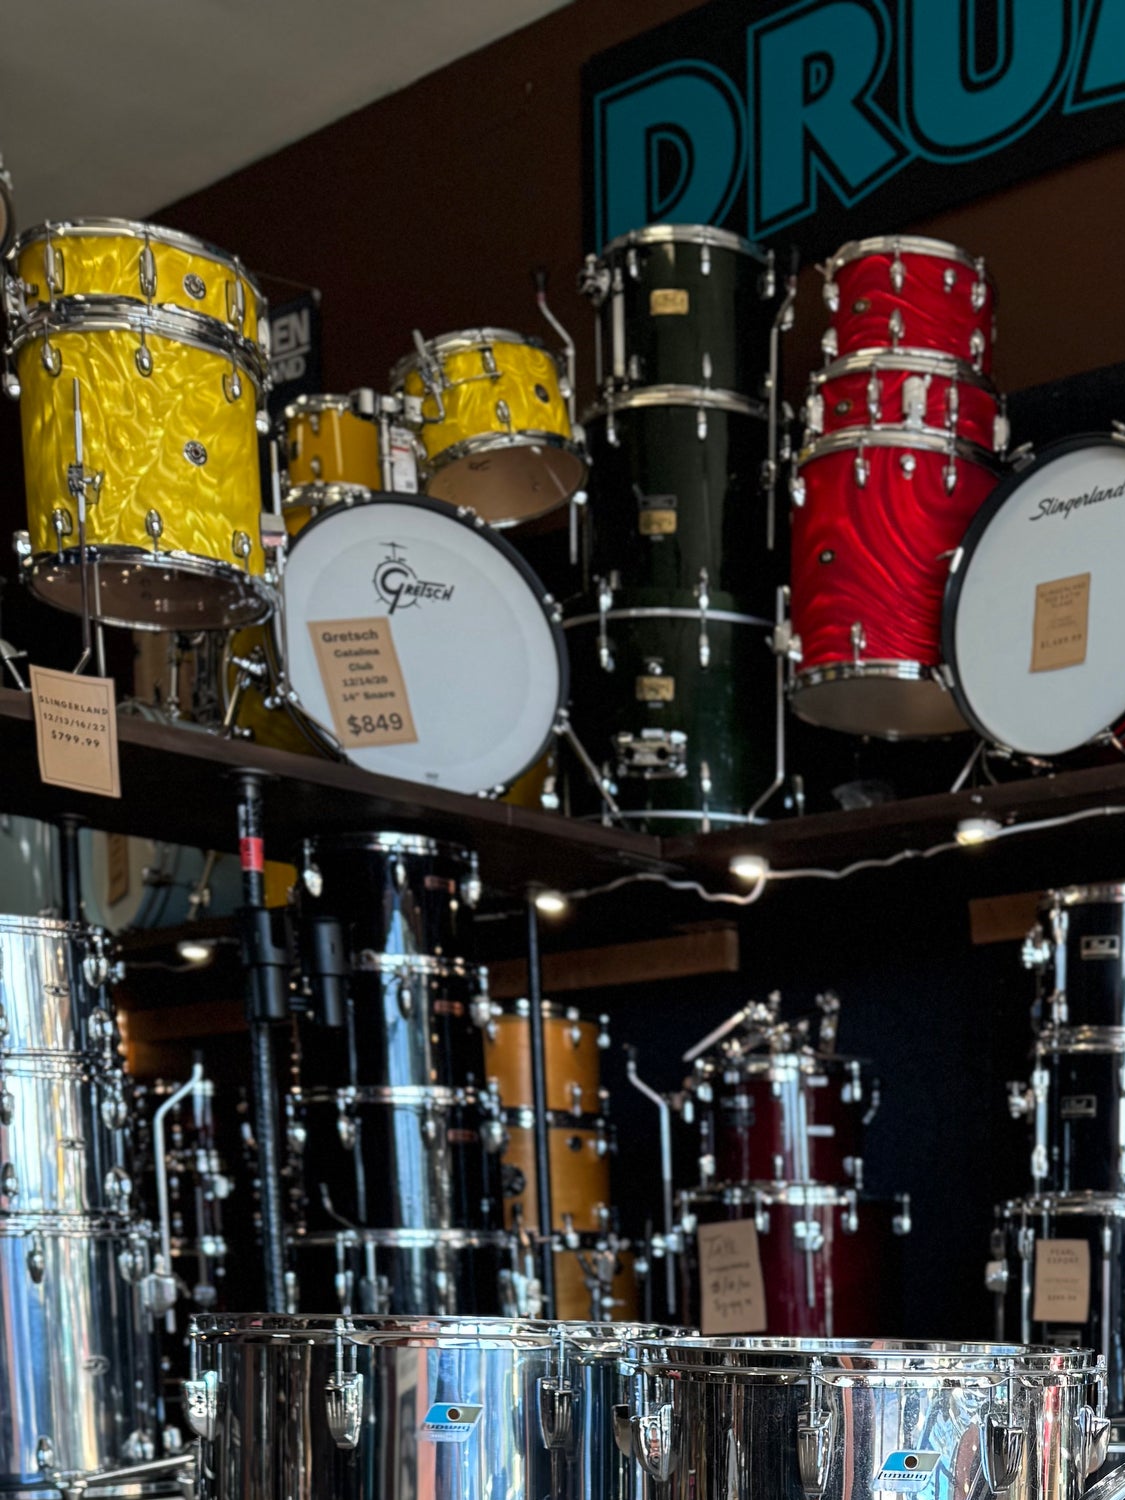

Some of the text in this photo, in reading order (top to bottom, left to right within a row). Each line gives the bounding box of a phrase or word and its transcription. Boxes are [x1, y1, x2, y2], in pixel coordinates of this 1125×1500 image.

[322, 629, 379, 643] Gretsch
[333, 648, 380, 658] Catalina
[348, 662, 374, 672] Club
[39, 695, 109, 715] SLINGERLAND
[346, 712, 404, 736] $849
[51, 729, 100, 748] $799.99
